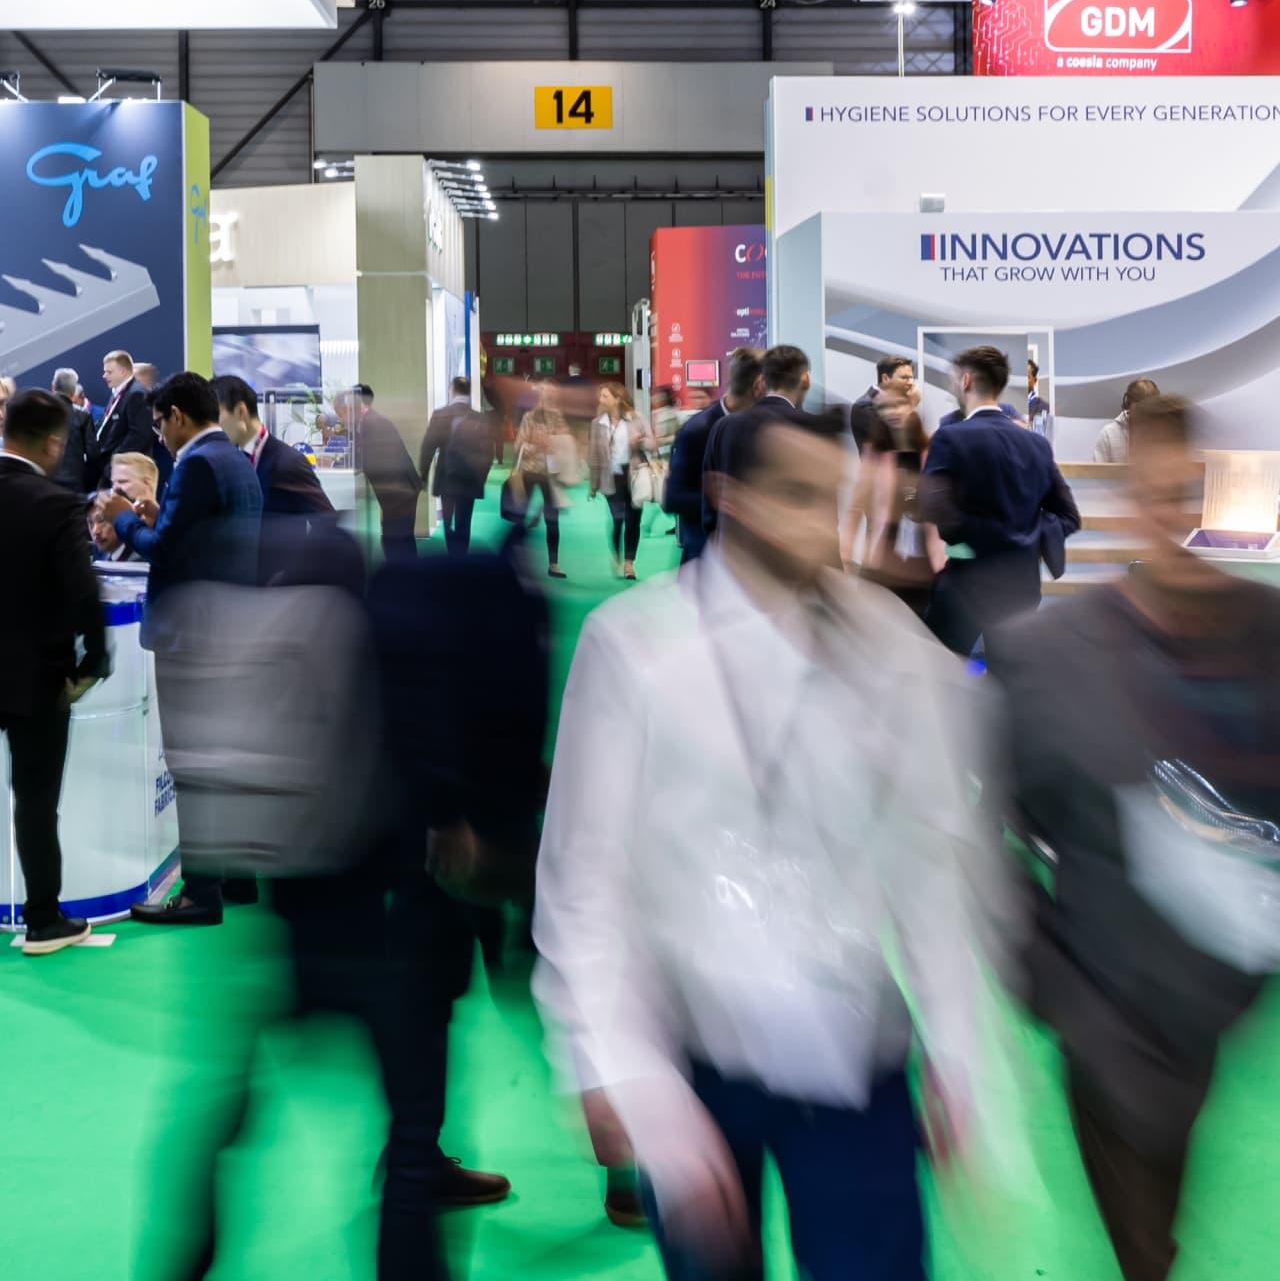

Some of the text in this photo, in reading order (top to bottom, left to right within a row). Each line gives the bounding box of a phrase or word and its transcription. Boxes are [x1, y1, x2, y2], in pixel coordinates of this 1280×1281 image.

[1080, 5, 1156, 38] GDM
[1056, 57, 1064, 68] a
[1105, 57, 1158, 71] company
[552, 90, 595, 124] 14
[820, 106, 909, 122] HYGIENE
[916, 106, 1031, 122] SOLUTIONS
[1038, 106, 1080, 121] FOR
[1085, 105, 1147, 121] EVERY
[26, 142, 158, 227] Graf
[939, 232, 1206, 261] INNOVATIONS
[940, 266, 1156, 281] THAT GROW WITH YOU
